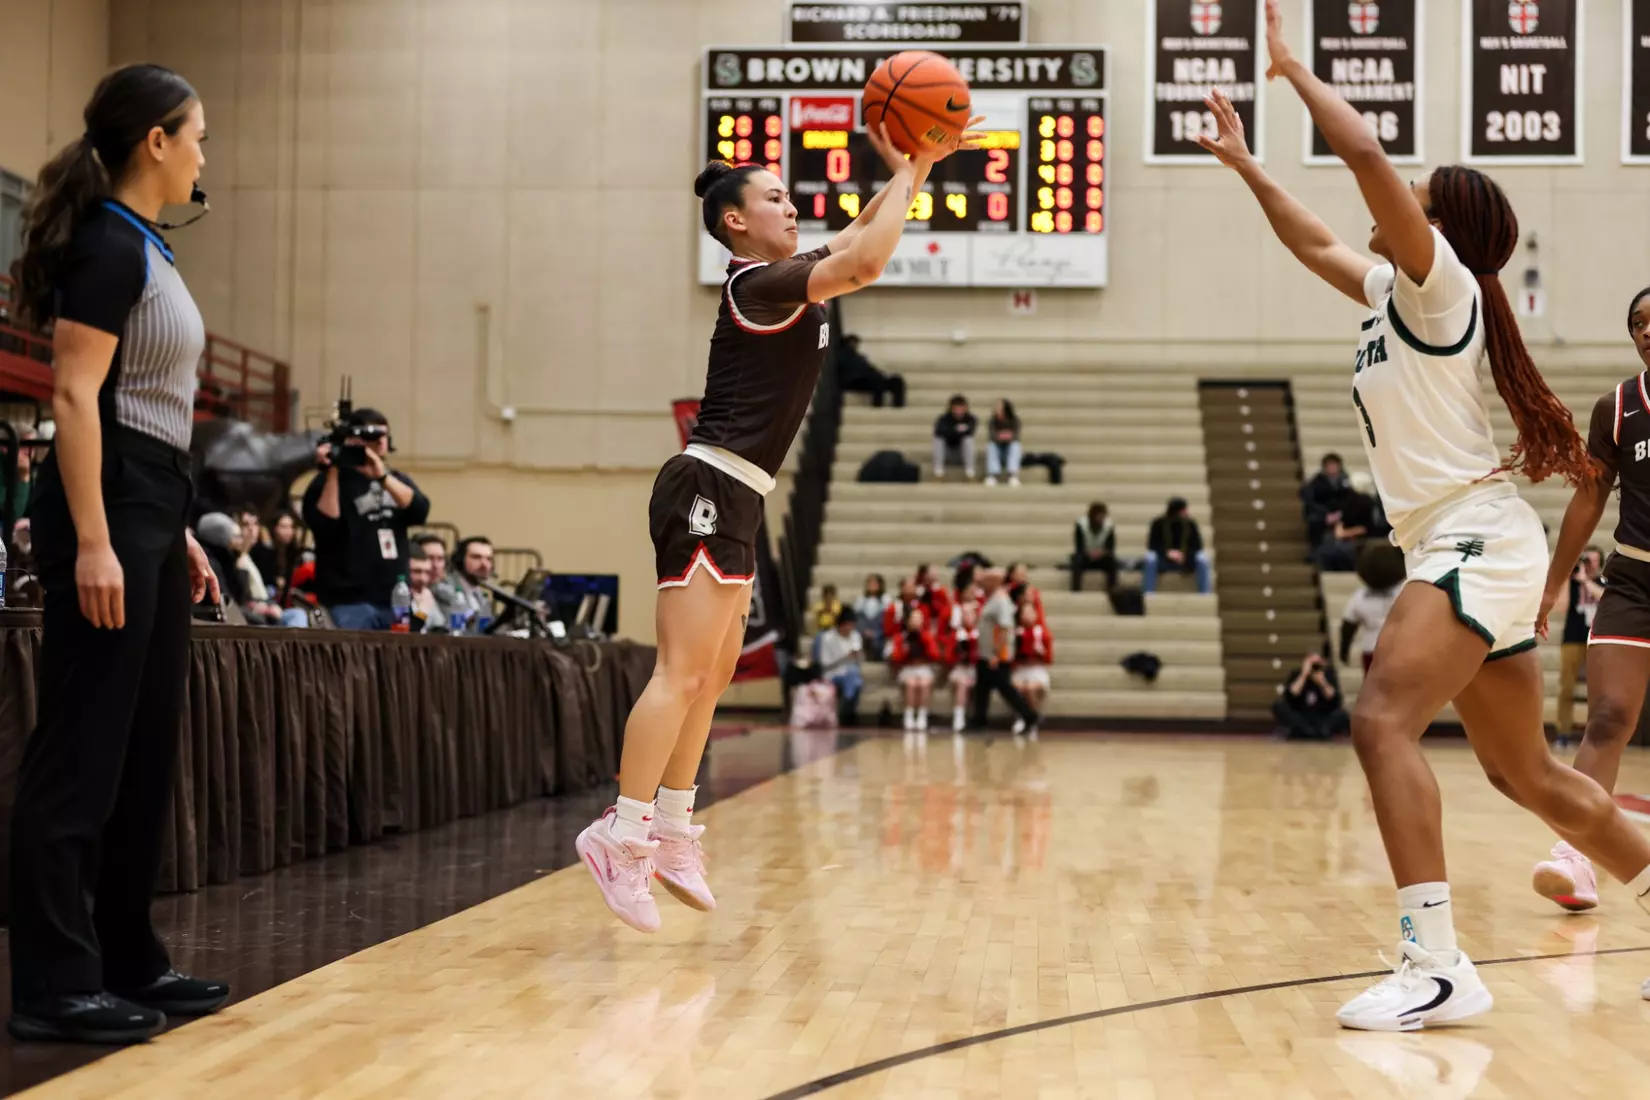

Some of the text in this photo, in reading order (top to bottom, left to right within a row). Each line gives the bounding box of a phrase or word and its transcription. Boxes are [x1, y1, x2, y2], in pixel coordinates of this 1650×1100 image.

[792, 6, 870, 22] RICHARD
[898, 6, 987, 21] FRIEDMAN
[843, 23, 961, 39] SCOREBOARD
[747, 57, 865, 82] BROWN
[1173, 57, 1236, 83] NCAA
[1331, 57, 1394, 83] NCAA
[1501, 64, 1547, 94] NIT
[1170, 110, 1220, 142] 193
[1486, 110, 1561, 142] 2003
[826, 148, 850, 182] 0
[985, 149, 1009, 183] 2
[987, 192, 1008, 220] 0
[689, 494, 717, 536] B
